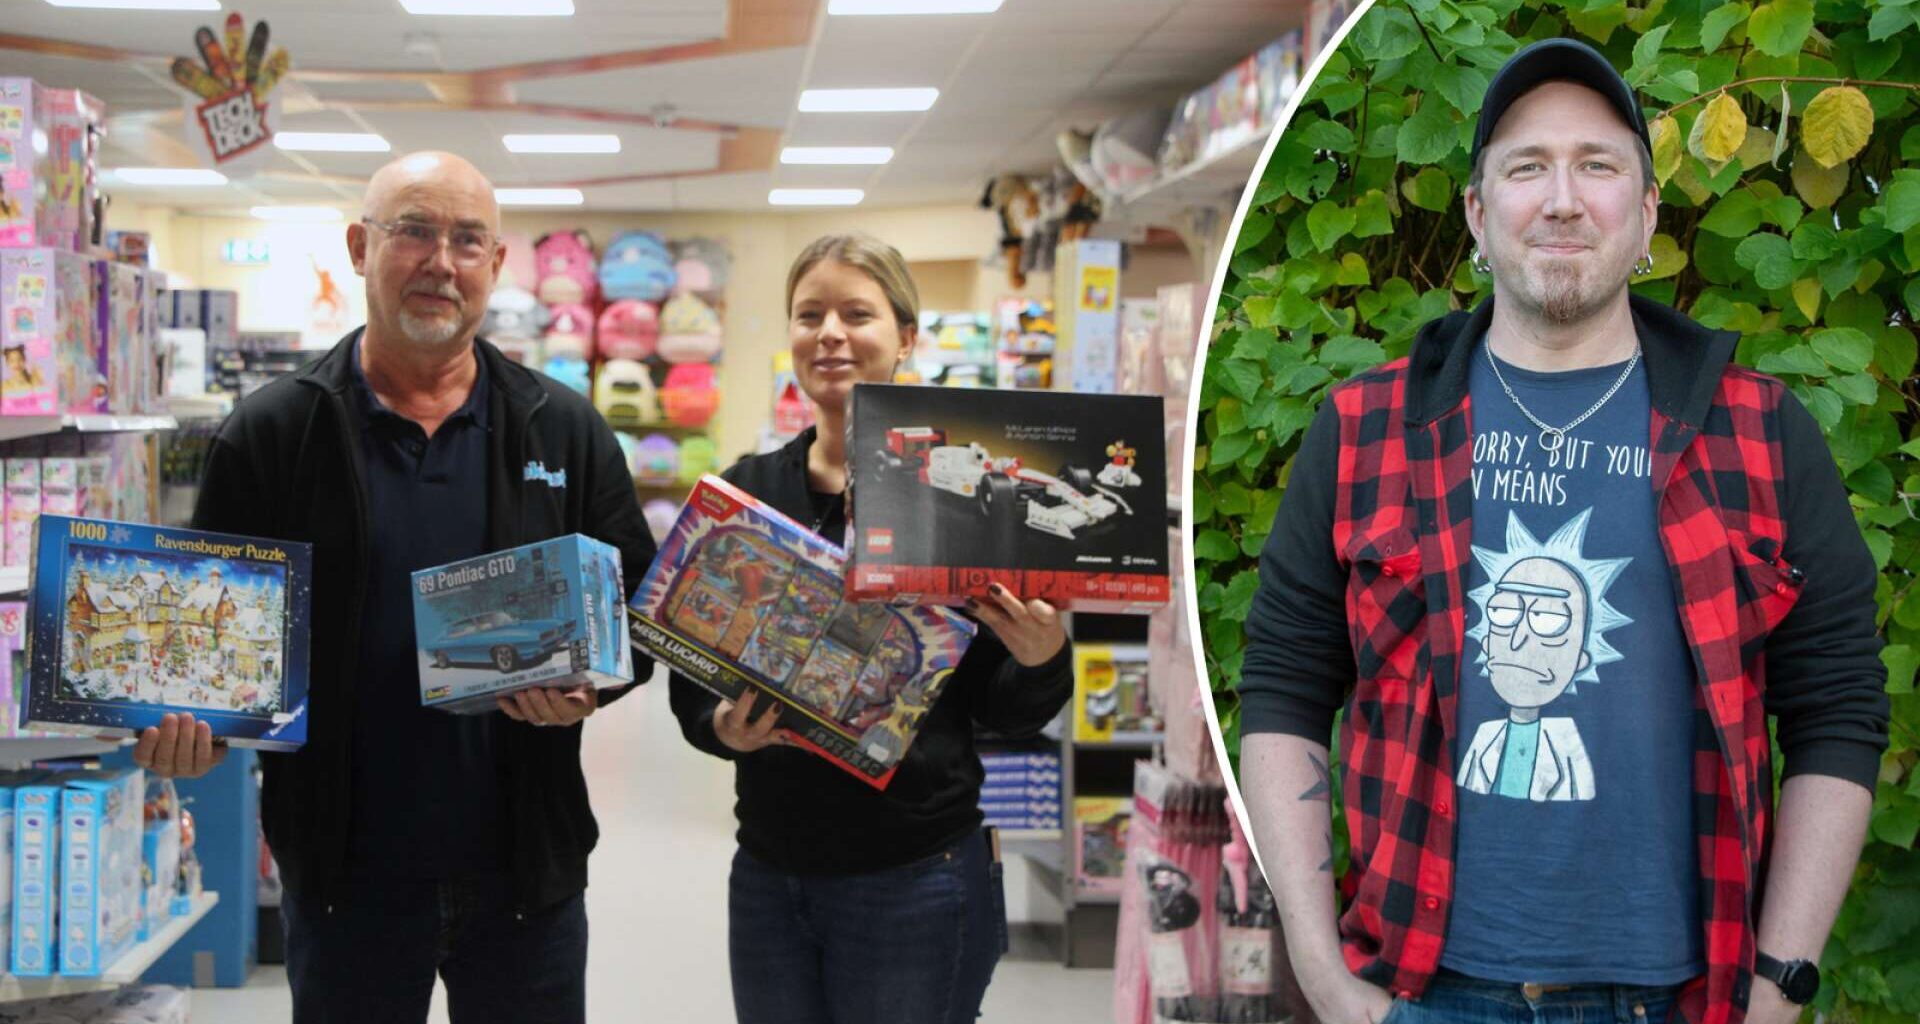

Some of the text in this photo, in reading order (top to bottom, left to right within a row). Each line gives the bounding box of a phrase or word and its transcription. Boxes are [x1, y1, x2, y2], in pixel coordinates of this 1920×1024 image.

[203, 92, 254, 132] TECH
[215, 113, 265, 155] DECK
[1471, 430, 1531, 469] ORRY,
[1548, 432, 1594, 470] BUT
[1493, 469, 1568, 506] MEANS
[68, 521, 108, 541] 1000
[154, 534, 287, 562] Ravensburger Puzzle
[437, 565, 486, 590] Pontiac
[487, 555, 516, 578] GTO
[631, 621, 667, 647] MEGA
[665, 639, 720, 675] LUCARIO
